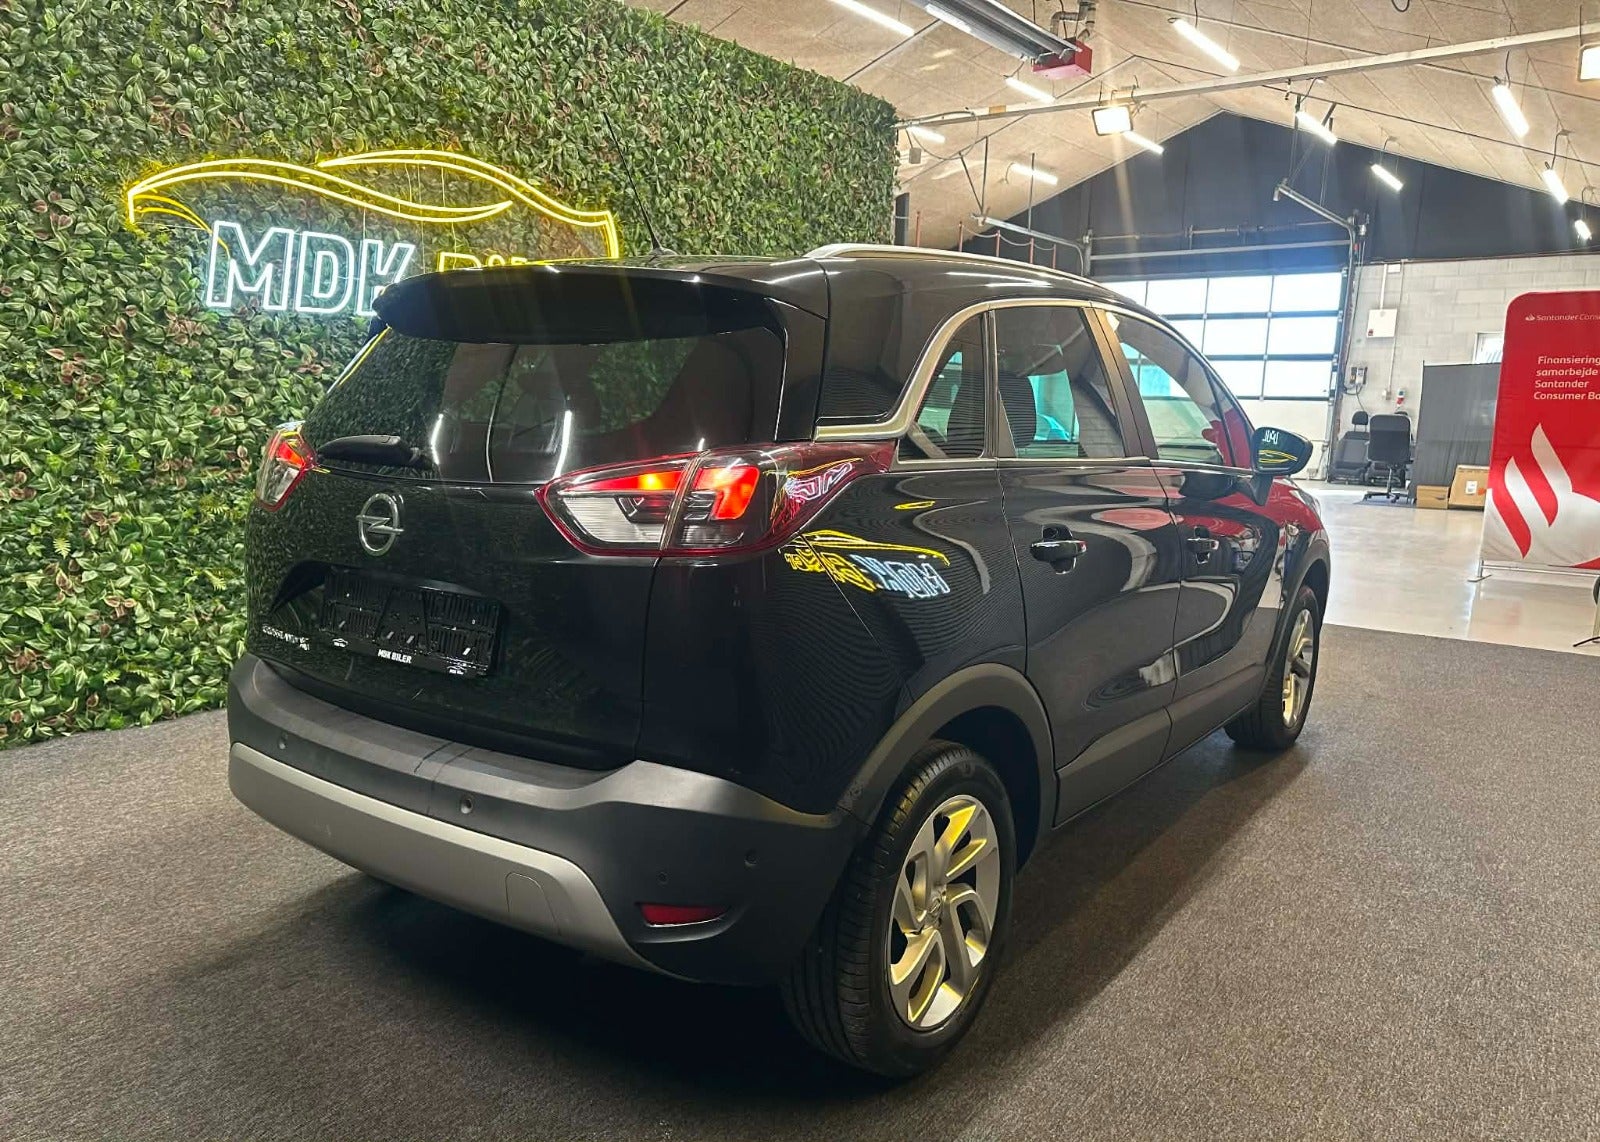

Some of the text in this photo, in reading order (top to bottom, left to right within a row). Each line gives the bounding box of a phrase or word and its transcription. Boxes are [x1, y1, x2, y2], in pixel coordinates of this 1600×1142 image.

[206, 220, 416, 317] MDK
[1536, 313, 1600, 321] Santander Cons
[1537, 355, 1600, 366] Finansiering
[1536, 367, 1599, 378] samarbejde
[1534, 379, 1590, 389] Santander
[1533, 391, 1586, 400] Consumer
[391, 651, 412, 664] BILER
